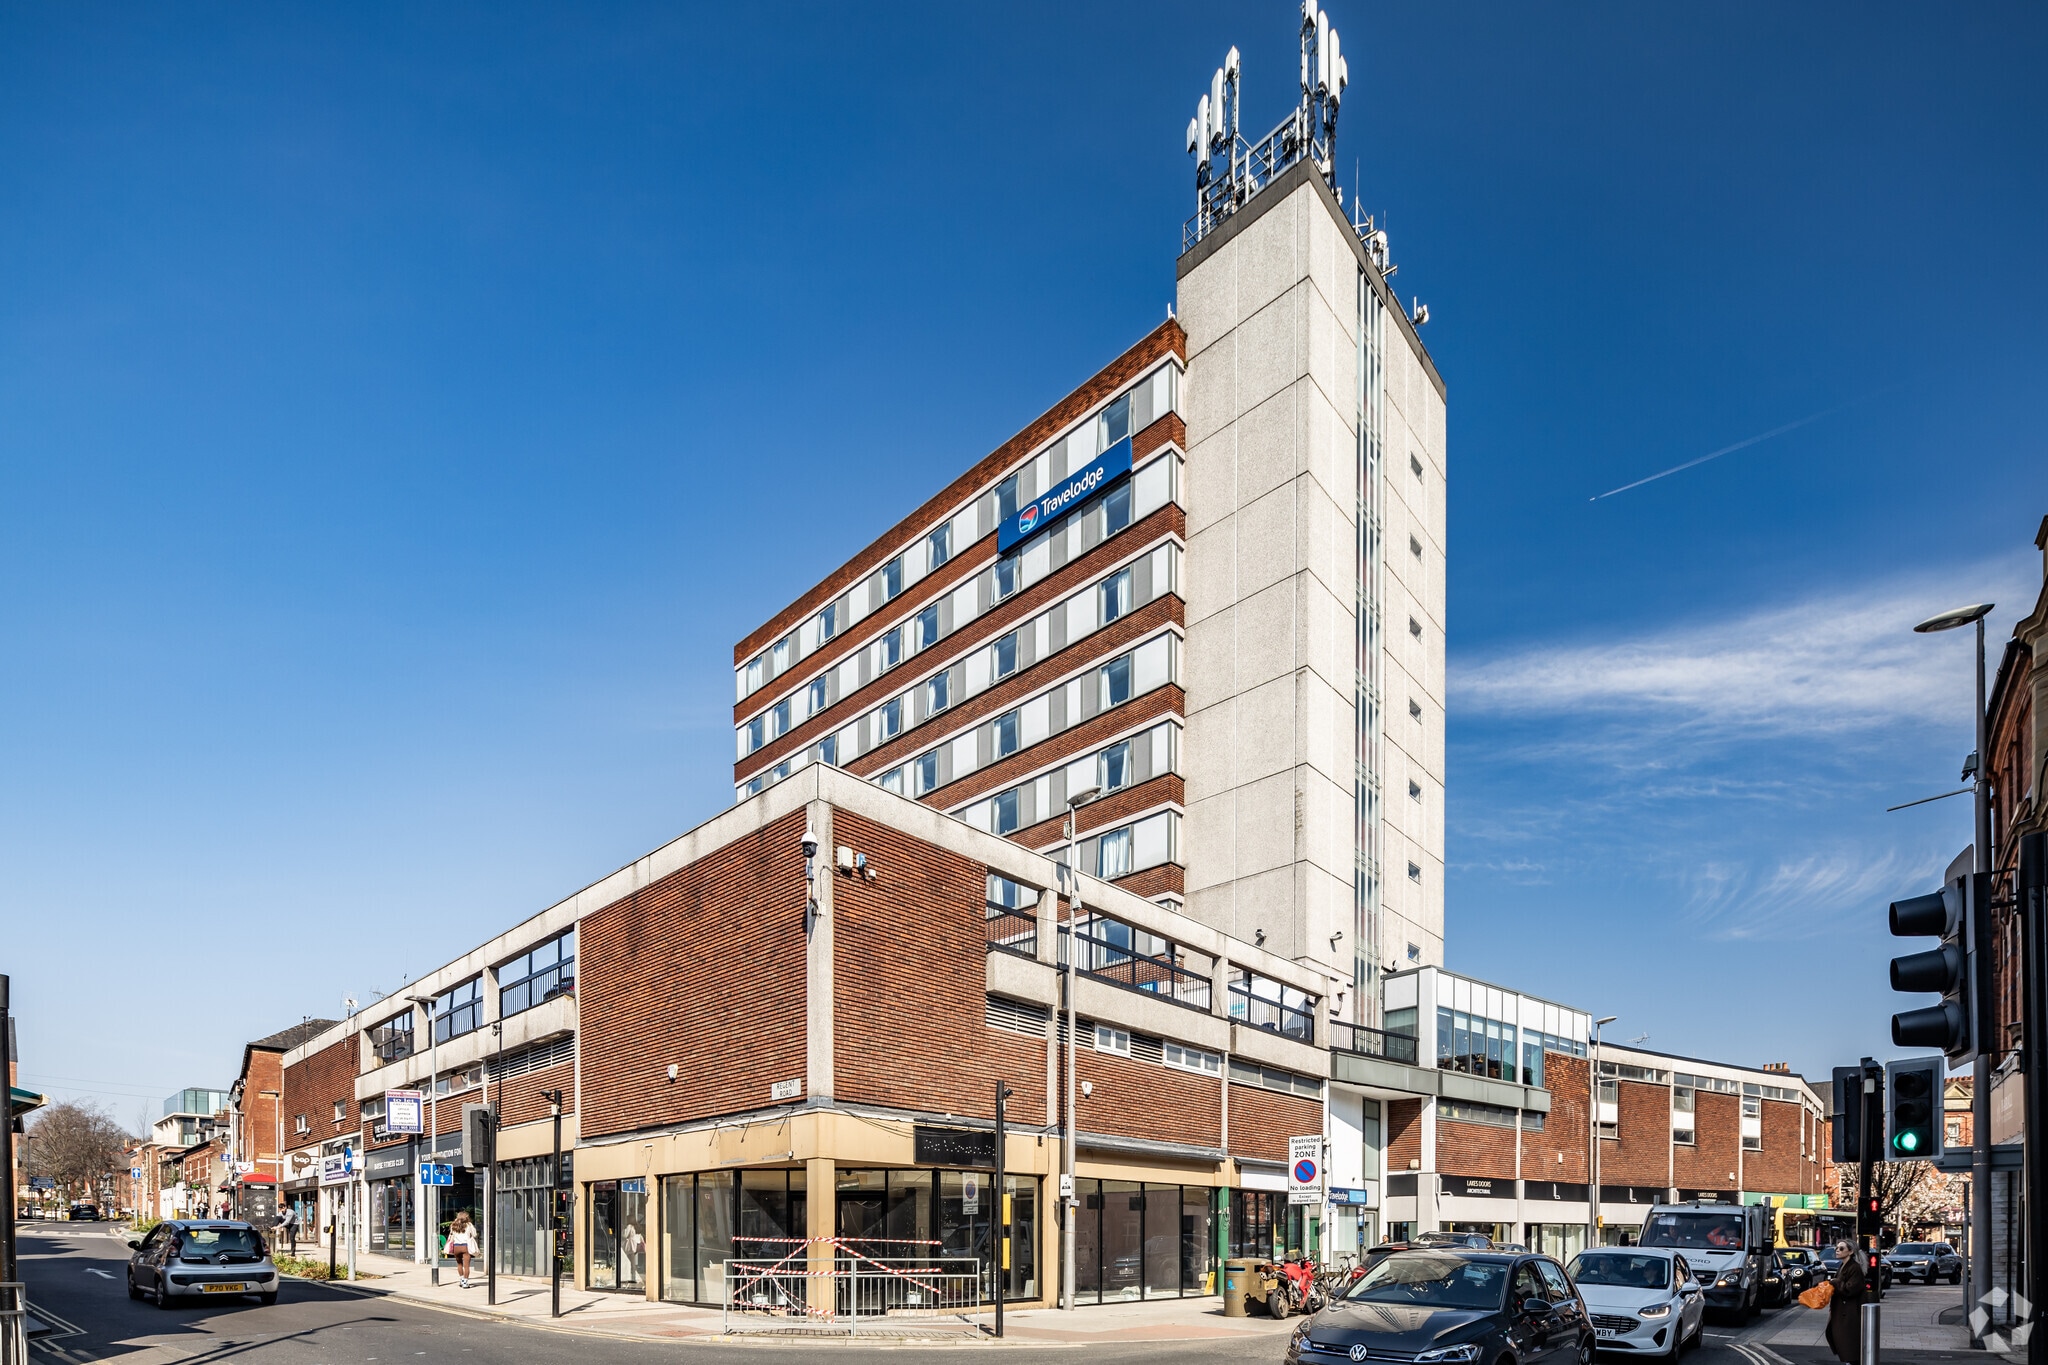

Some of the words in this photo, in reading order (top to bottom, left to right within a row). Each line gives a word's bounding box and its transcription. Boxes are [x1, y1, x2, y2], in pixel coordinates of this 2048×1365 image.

[1041, 467, 1104, 517] Travelodge
[776, 1080, 795, 1090] REGENT
[779, 1089, 793, 1097] ROAD
[293, 1156, 310, 1165] bap
[1596, 1329, 1613, 1338] WBY
